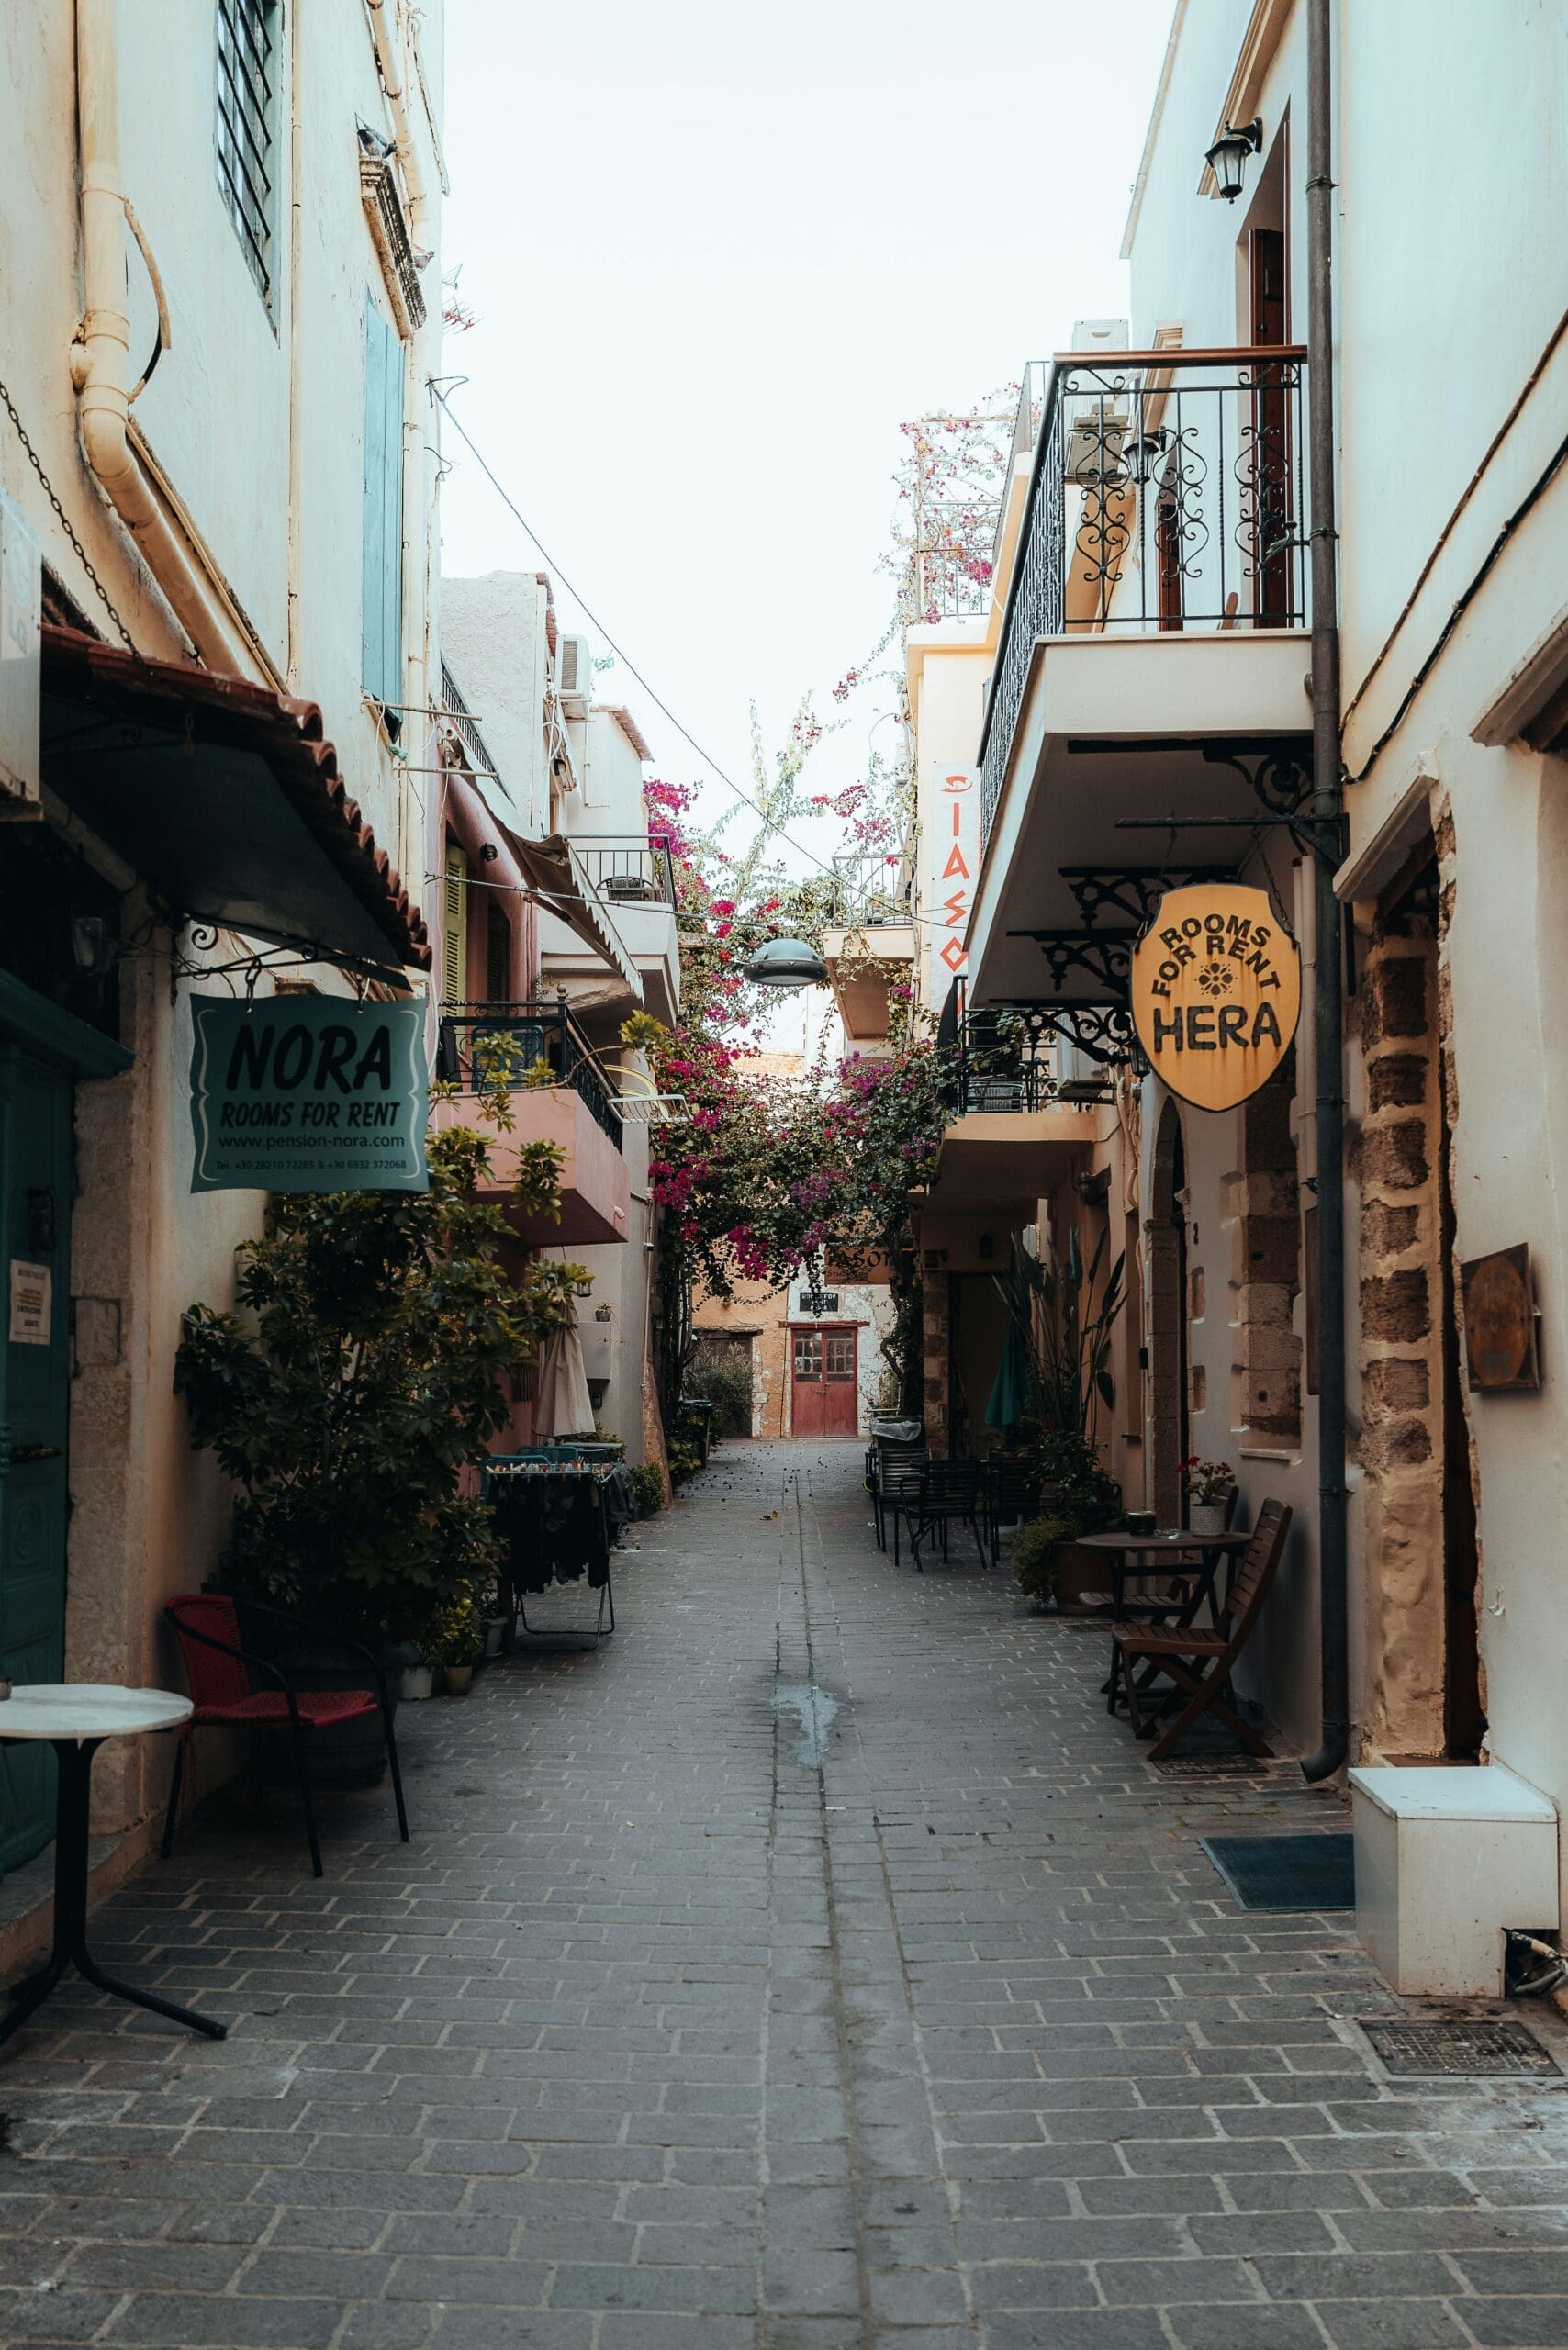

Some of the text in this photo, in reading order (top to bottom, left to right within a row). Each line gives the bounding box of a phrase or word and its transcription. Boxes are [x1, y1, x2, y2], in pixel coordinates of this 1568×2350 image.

[1159, 913, 1271, 951] ROOMS
[1151, 935, 1282, 998] FOR RENT
[1153, 1002, 1282, 1053] HERA
[226, 1024, 391, 1094] NORA
[220, 1102, 401, 1128] ROOMS FOR RENT
[218, 1134, 406, 1150] www.pension-nora.com
[235, 1160, 251, 1170] +30
[329, 1160, 345, 1169] +30
[373, 1160, 406, 1169] 372068
